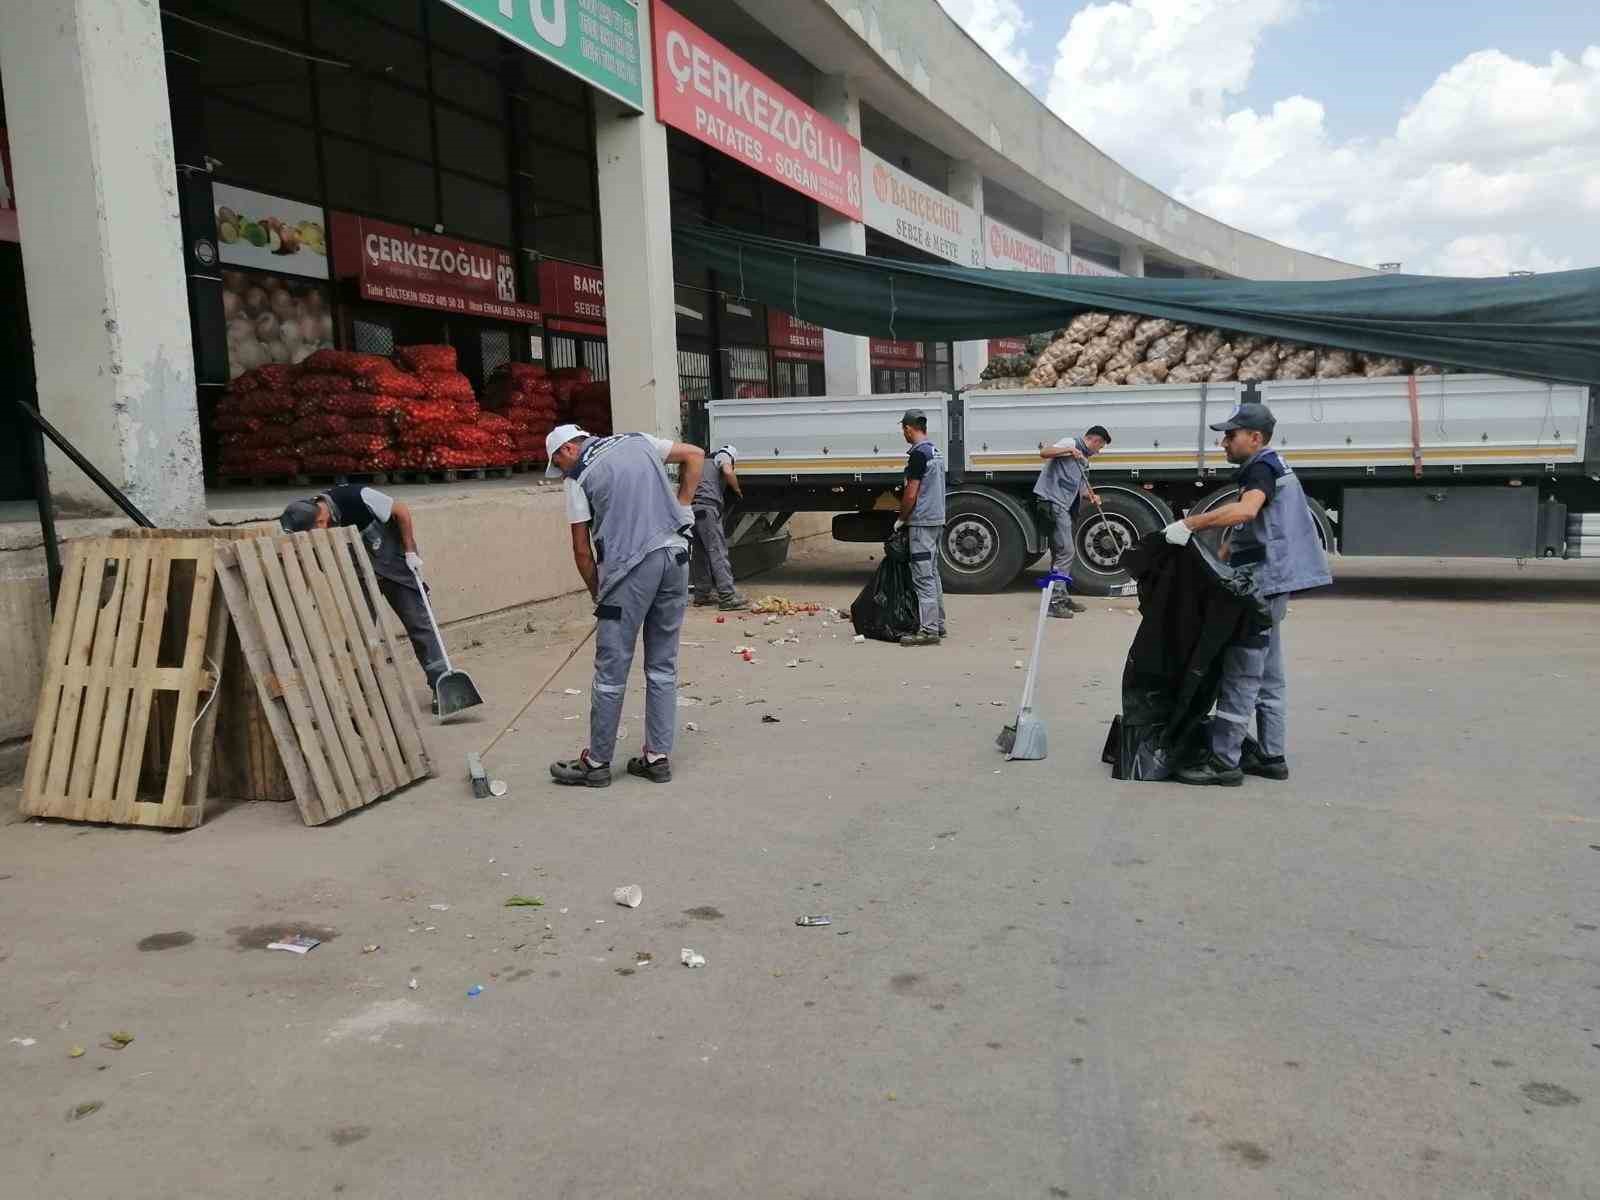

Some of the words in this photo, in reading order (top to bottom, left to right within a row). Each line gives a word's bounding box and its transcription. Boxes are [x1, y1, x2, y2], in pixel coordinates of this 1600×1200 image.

[666, 30, 843, 174] ÇERKEZOĞLU
[696, 106, 763, 163] PATATES
[776, 152, 818, 193] SOĞAN
[366, 234, 491, 280] ÇERKEZOĞLU
